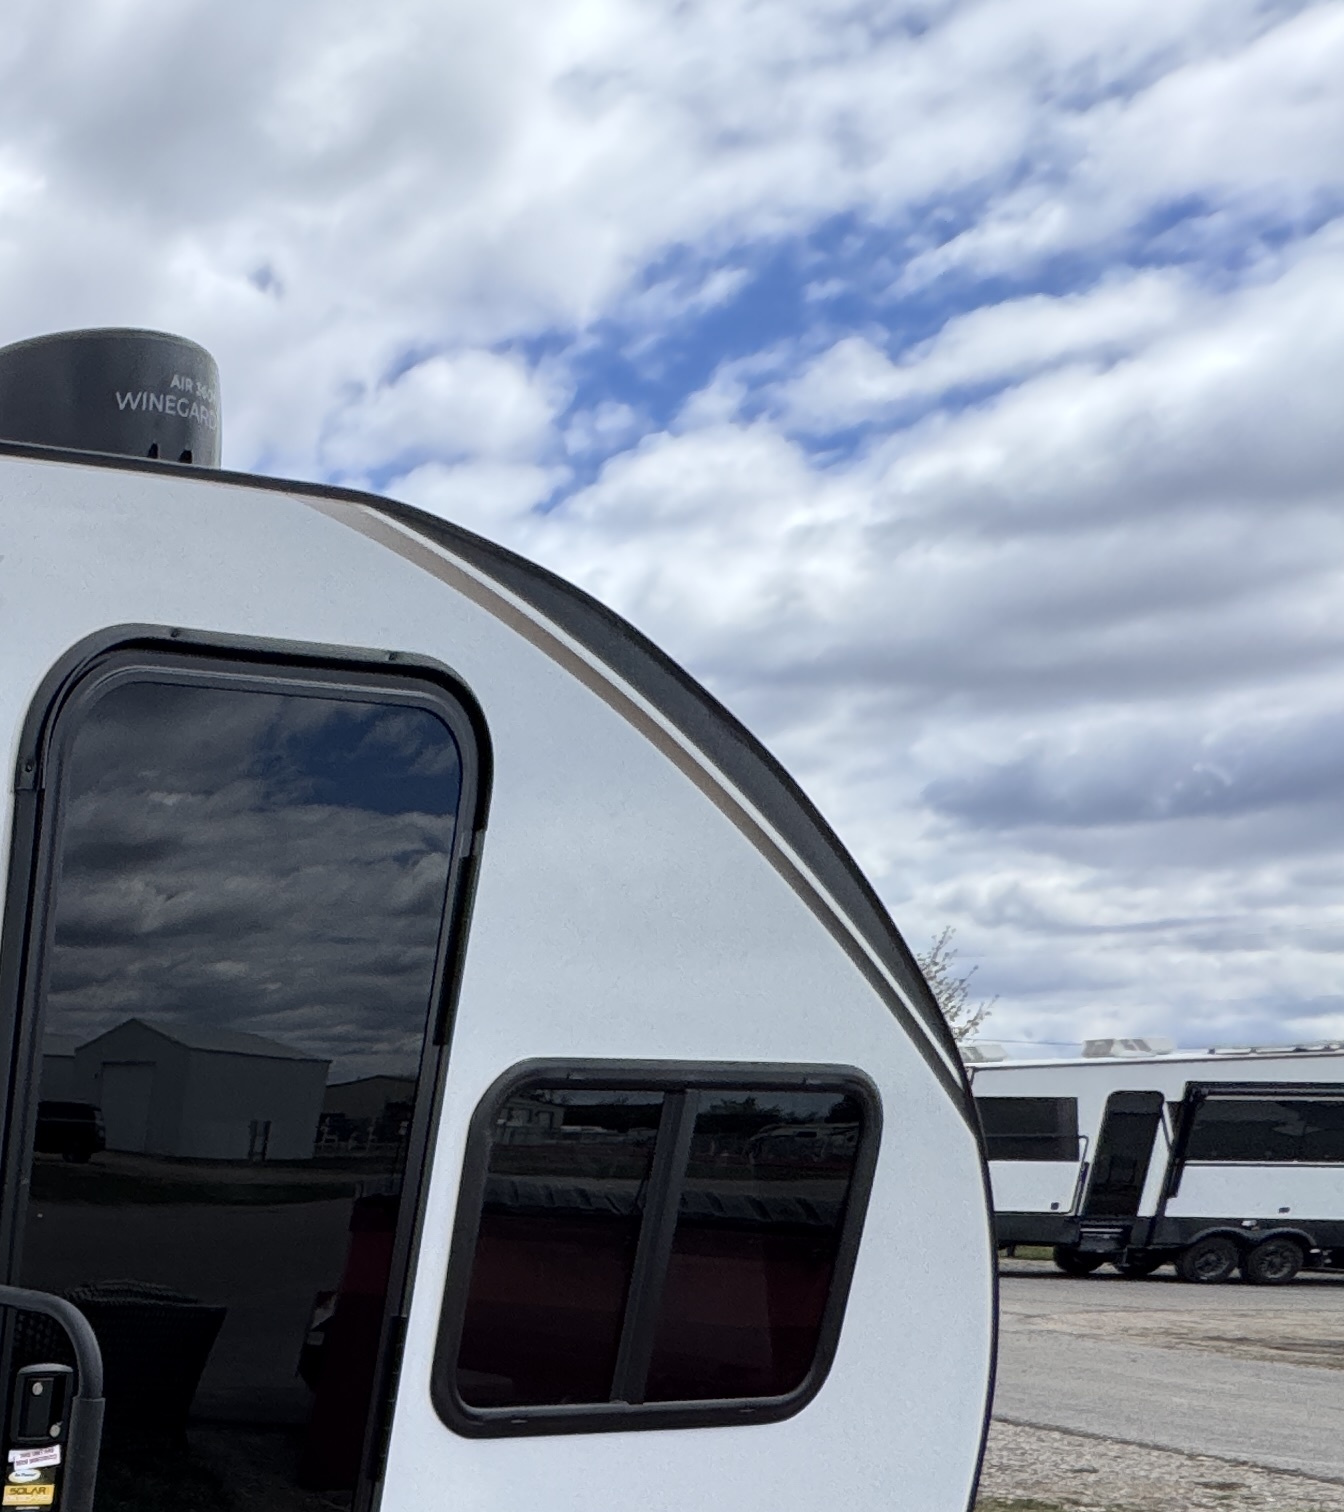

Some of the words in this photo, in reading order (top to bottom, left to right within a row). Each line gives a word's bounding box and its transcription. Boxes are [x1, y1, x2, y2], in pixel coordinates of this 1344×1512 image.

[170, 374, 193, 393] AIR
[115, 391, 217, 431] WINEGARD
[9, 1486, 47, 1496] SOLAR
